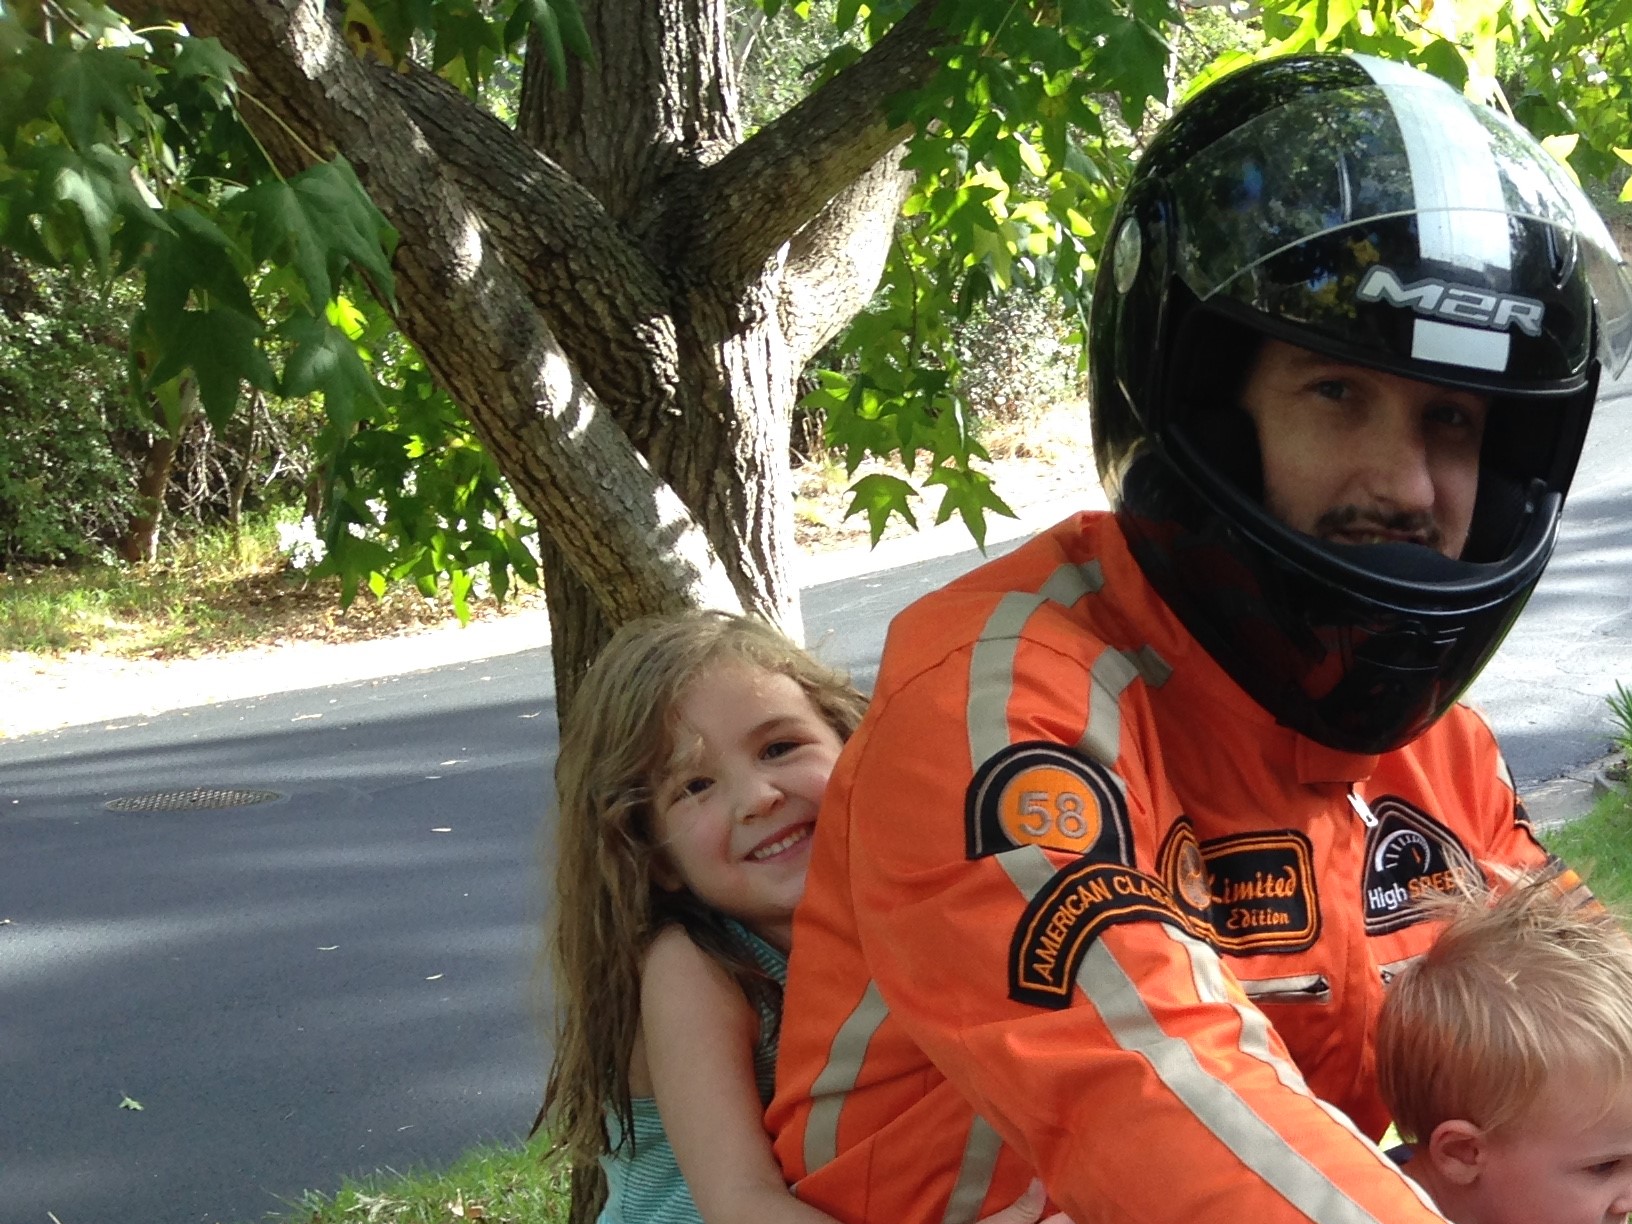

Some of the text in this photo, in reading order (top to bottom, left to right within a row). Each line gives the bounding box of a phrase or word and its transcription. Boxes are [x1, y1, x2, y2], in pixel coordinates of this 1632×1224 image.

[1359, 265, 1545, 336] M2R
[1017, 791, 1089, 839] 58
[1226, 907, 1291, 930] Edition
[1367, 882, 1409, 910] High
[1032, 876, 1113, 983] AMERICAN
